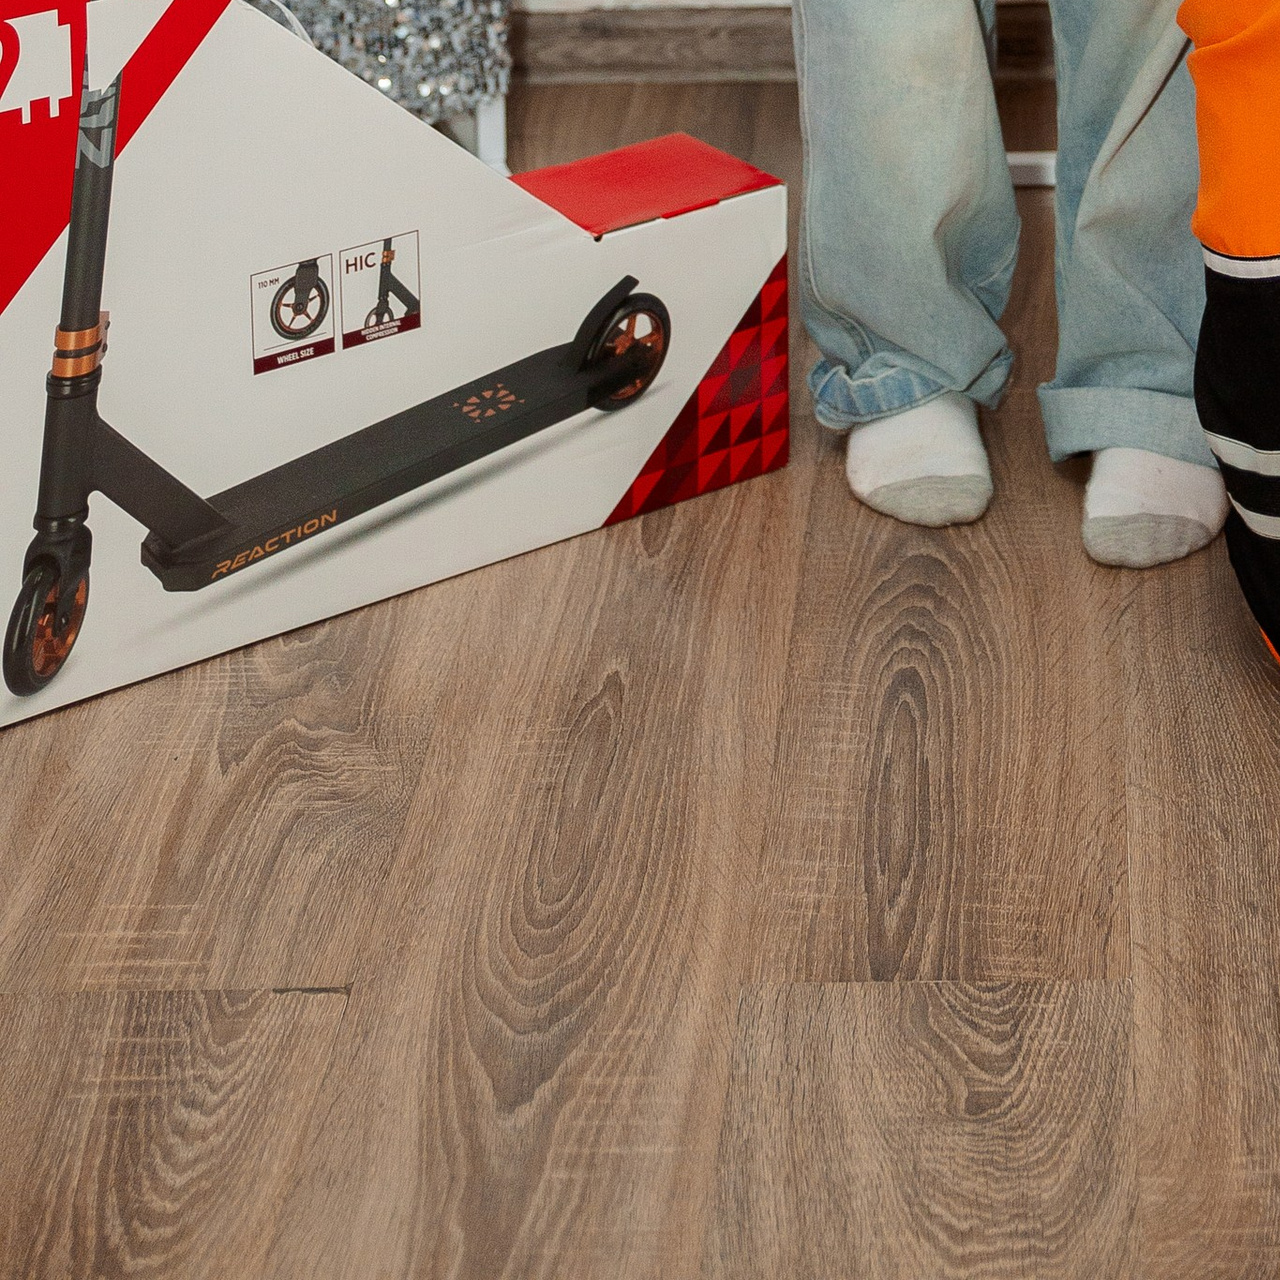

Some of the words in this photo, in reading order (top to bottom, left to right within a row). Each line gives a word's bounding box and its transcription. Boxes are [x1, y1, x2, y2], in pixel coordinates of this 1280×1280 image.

[345, 252, 377, 274] HIC
[258, 281, 268, 289] 110
[269, 277, 280, 287] MM
[277, 350, 299, 364] WHEEL
[300, 347, 315, 358] SIZE
[211, 509, 337, 579] REACTION
